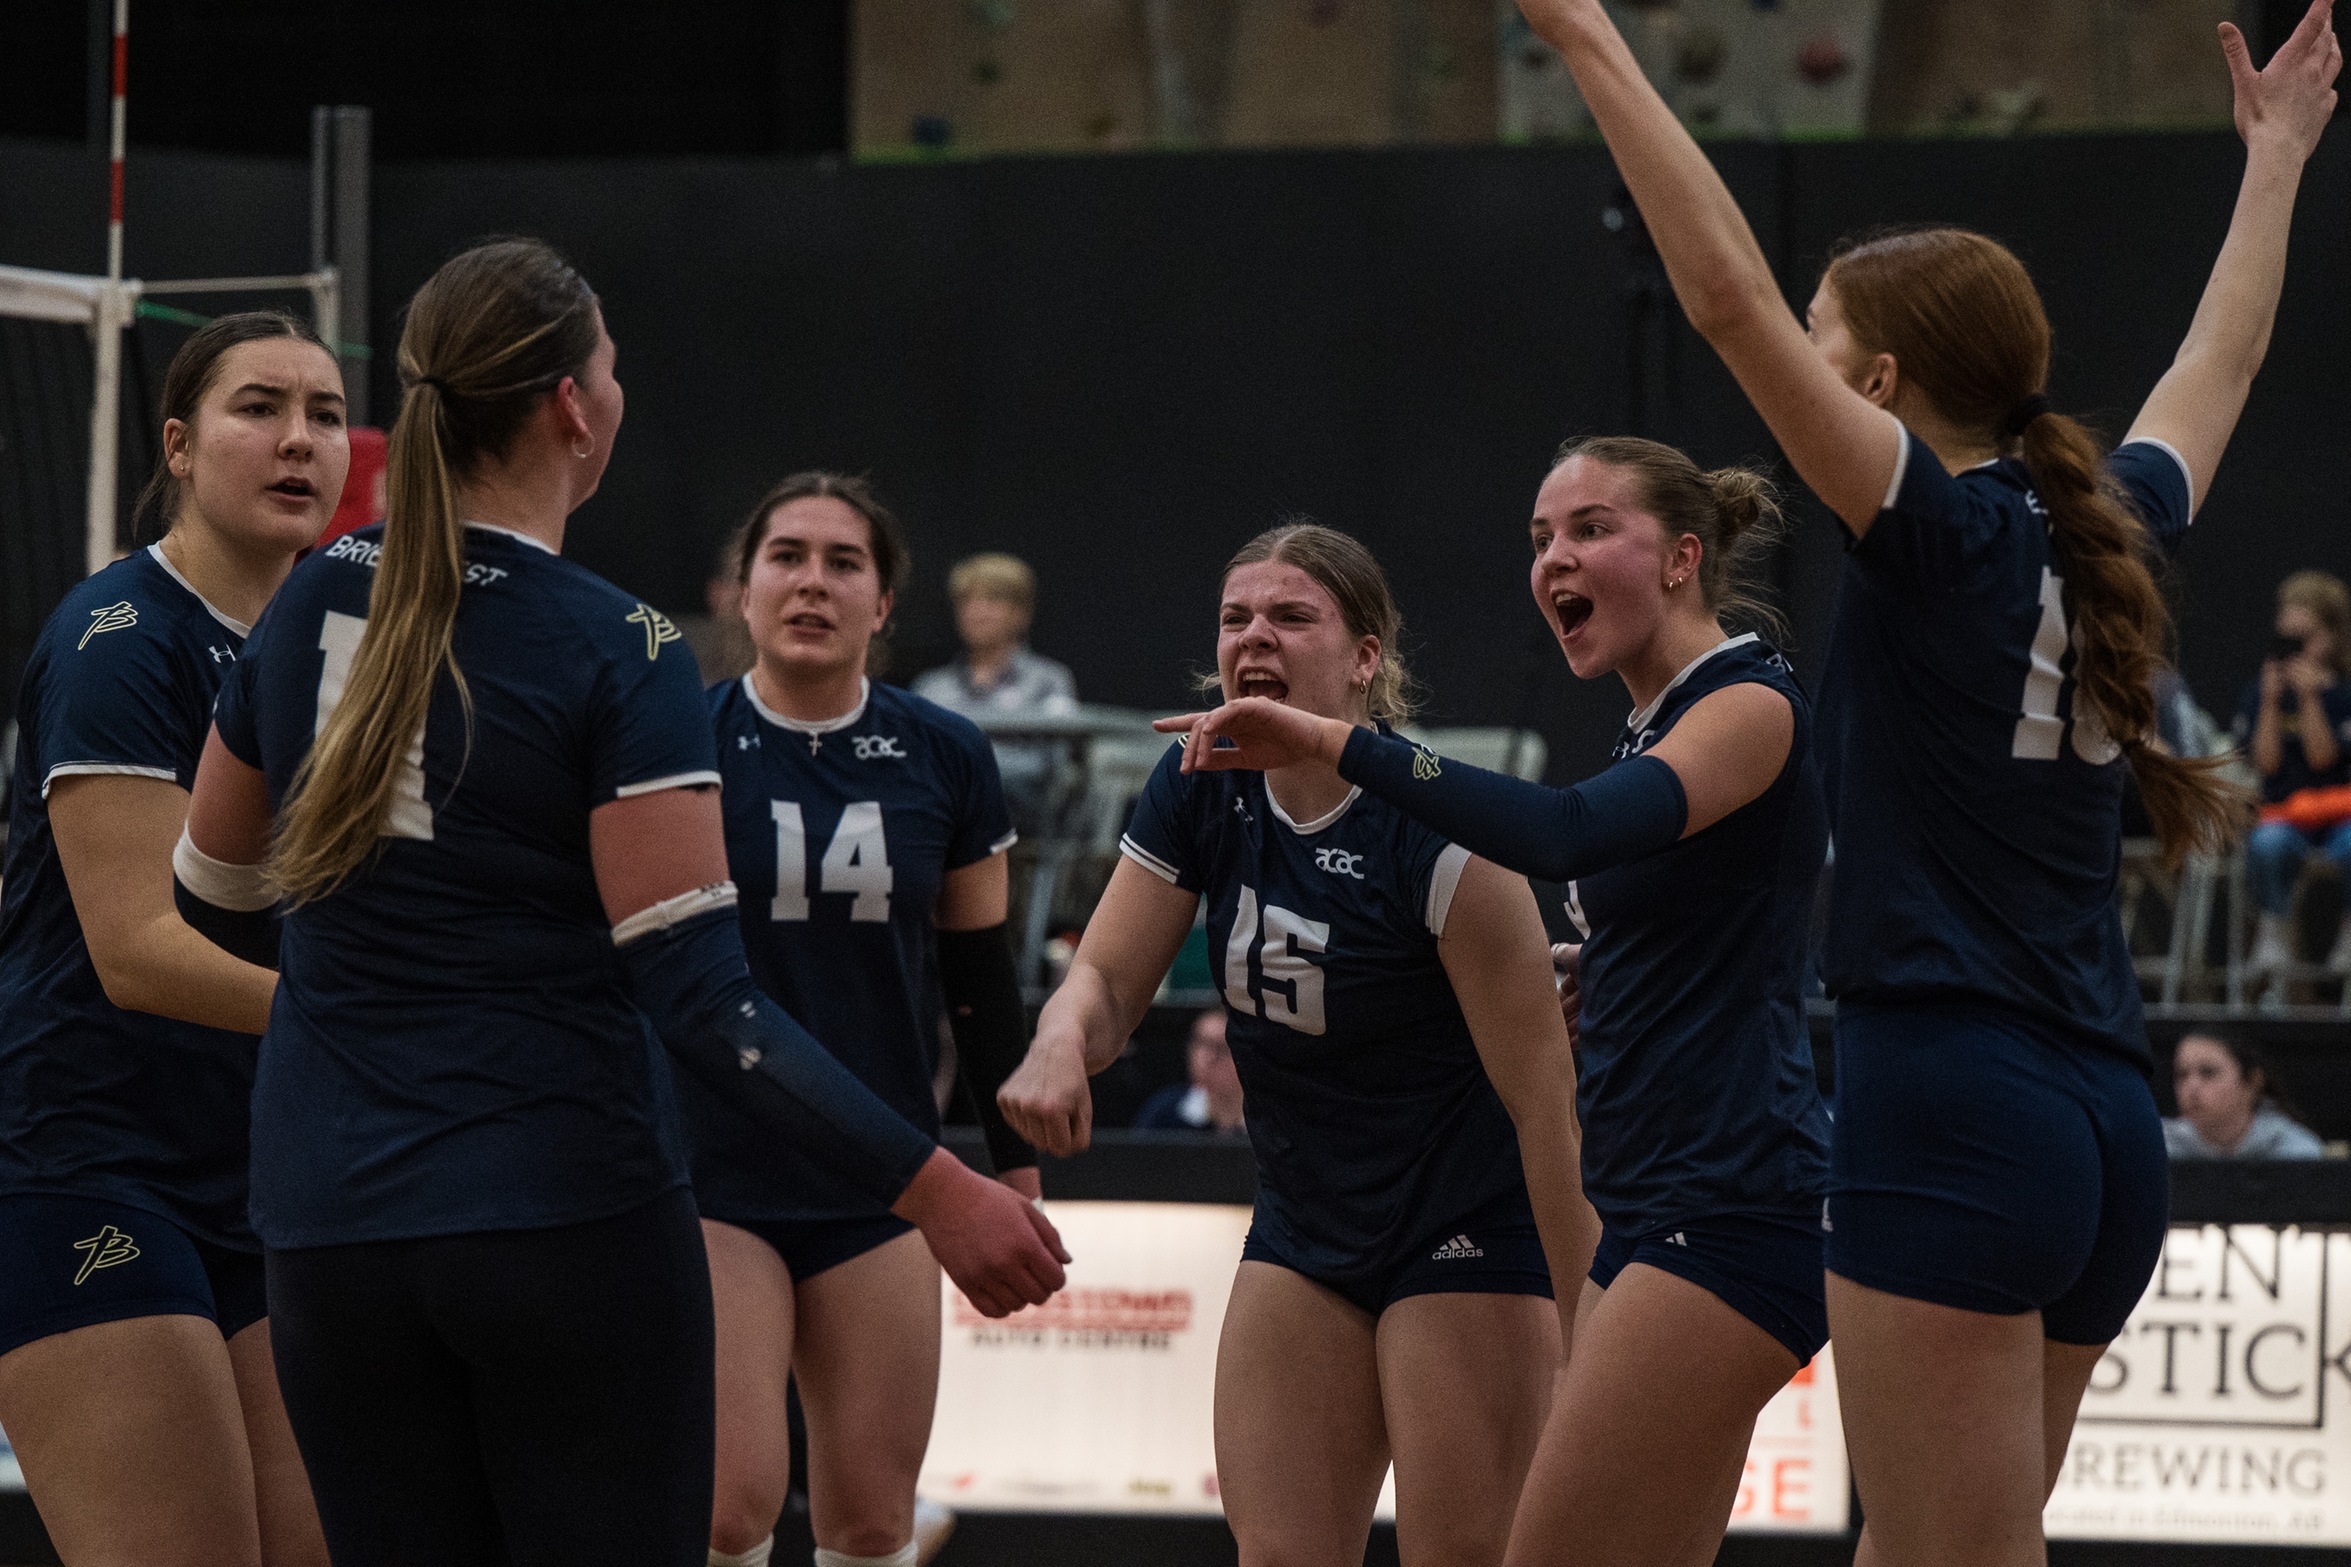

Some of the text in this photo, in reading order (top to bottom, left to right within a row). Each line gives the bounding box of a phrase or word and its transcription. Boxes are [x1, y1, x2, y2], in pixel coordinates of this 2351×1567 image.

[771, 798, 894, 924] 14
[1223, 883, 1330, 1036] 15
[1431, 1247, 1484, 1261] adidas
[2062, 1442, 2328, 1498] REWING
